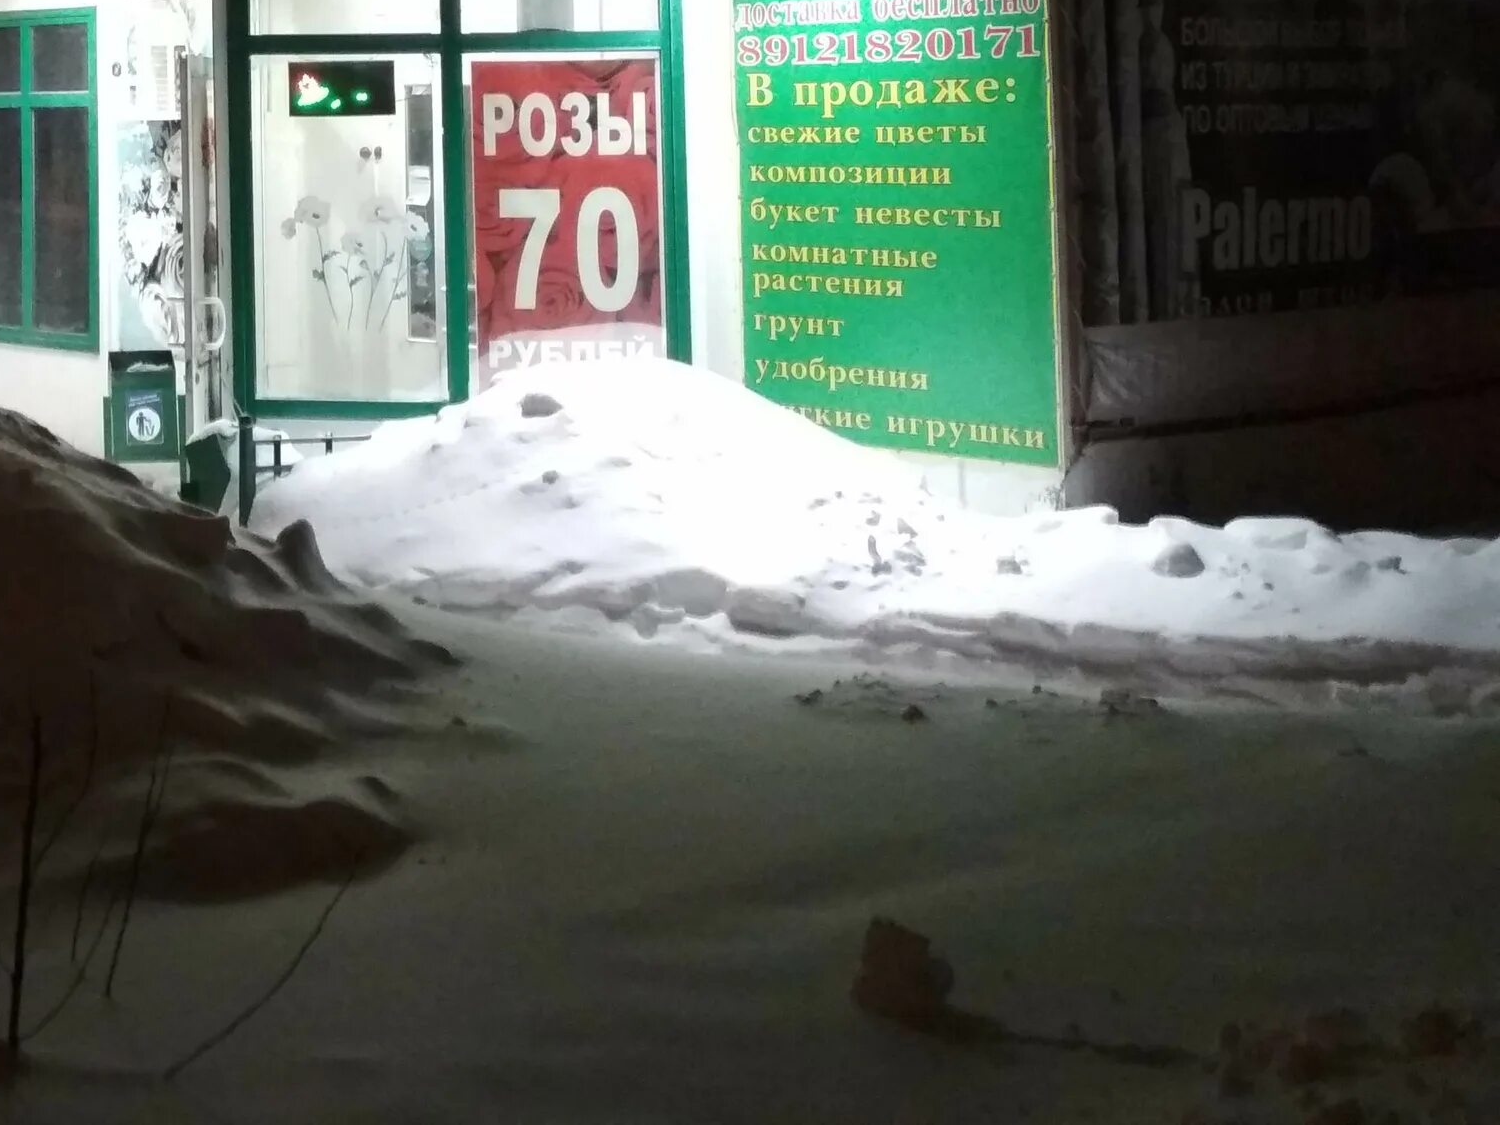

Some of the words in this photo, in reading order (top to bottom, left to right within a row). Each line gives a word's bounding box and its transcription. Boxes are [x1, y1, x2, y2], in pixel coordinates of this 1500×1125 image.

[737, 24, 1041, 67] 89121820171
[746, 73, 774, 107] В
[794, 75, 1017, 119] продаже:
[482, 92, 647, 157] РОЗЫ
[748, 125, 861, 145] свежие
[875, 124, 988, 147] цветы
[750, 163, 952, 186] композиции
[750, 197, 841, 229] букет
[855, 205, 1001, 228] невесты
[1180, 186, 1372, 273] Palermo
[499, 186, 640, 313] 70
[752, 242, 937, 269] комнатные
[752, 271, 905, 299] растения
[753, 311, 845, 342] грунт
[755, 356, 929, 393] удобрения
[886, 414, 1045, 450] игрушки
